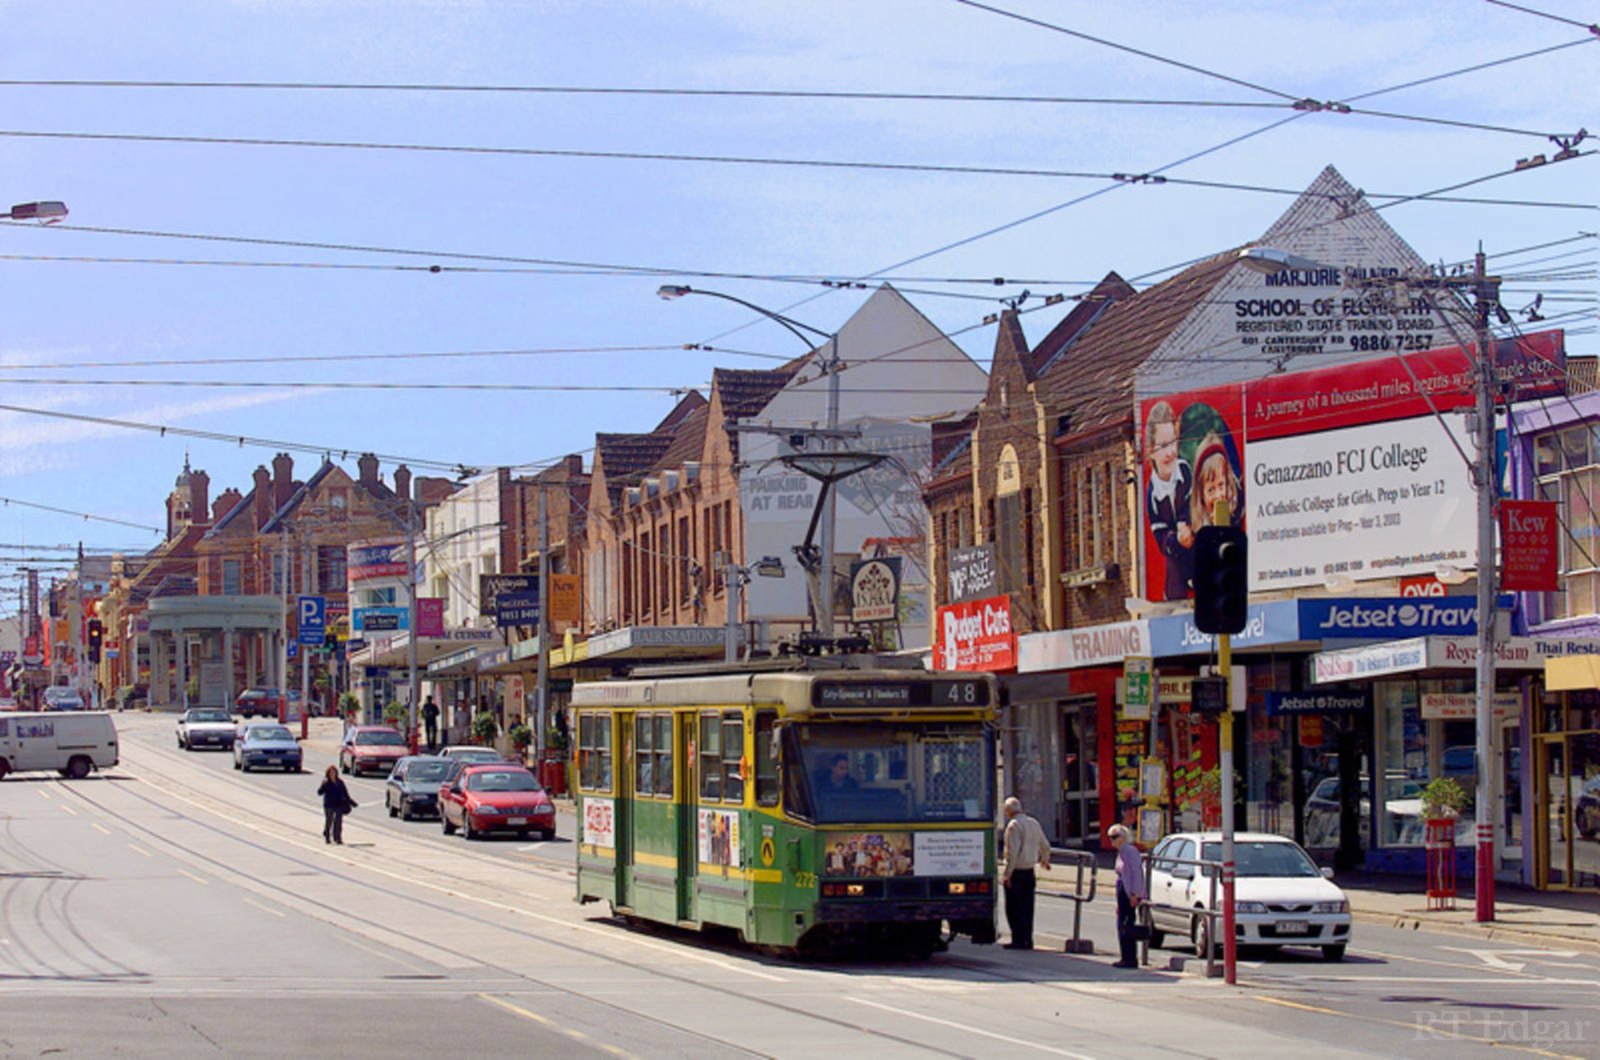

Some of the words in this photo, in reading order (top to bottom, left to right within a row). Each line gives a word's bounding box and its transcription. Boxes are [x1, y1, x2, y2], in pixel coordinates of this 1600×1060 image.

[1265, 269, 1341, 287] MARJORIE
[1235, 299, 1306, 317] SCHOOL
[1313, 299, 1335, 316] OF
[1236, 319, 1302, 332] REGISTERED
[1307, 319, 1342, 332] STATE
[1346, 319, 1392, 331] TRAINING
[1397, 319, 1434, 331] BOARD
[1350, 335, 1390, 351] 9880
[1396, 334, 1433, 351] 7257
[1266, 399, 1304, 421] journey
[1307, 393, 1320, 411] of
[1330, 384, 1378, 406] thousand
[1381, 380, 1410, 398] miles
[1254, 461, 1333, 486] Genazzano
[1337, 449, 1365, 475] FCJ
[1370, 443, 1427, 473] College
[751, 496, 772, 510] AT
[777, 494, 813, 510] REAR
[1257, 504, 1265, 518] A
[1266, 498, 1301, 516] Catholic
[1302, 495, 1335, 515] College
[1337, 492, 1349, 508] for
[1378, 486, 1398, 505] Prep
[1400, 486, 1409, 499] to
[1410, 482, 1431, 498] Year
[1434, 479, 1445, 495] 12
[1507, 509, 1548, 532] Kew
[301, 600, 318, 626] P
[1319, 604, 1396, 629] Jetset
[1417, 603, 1479, 626] Trav
[944, 609, 983, 670] Budget
[984, 604, 1009, 637] Cuts
[1071, 624, 1141, 661] FRAMING
[1535, 641, 1563, 654] Thai
[948, 682, 976, 703] 48
[1278, 697, 1314, 710] Jetset
[1327, 695, 1365, 709] Travel
[794, 871, 815, 889] 272
